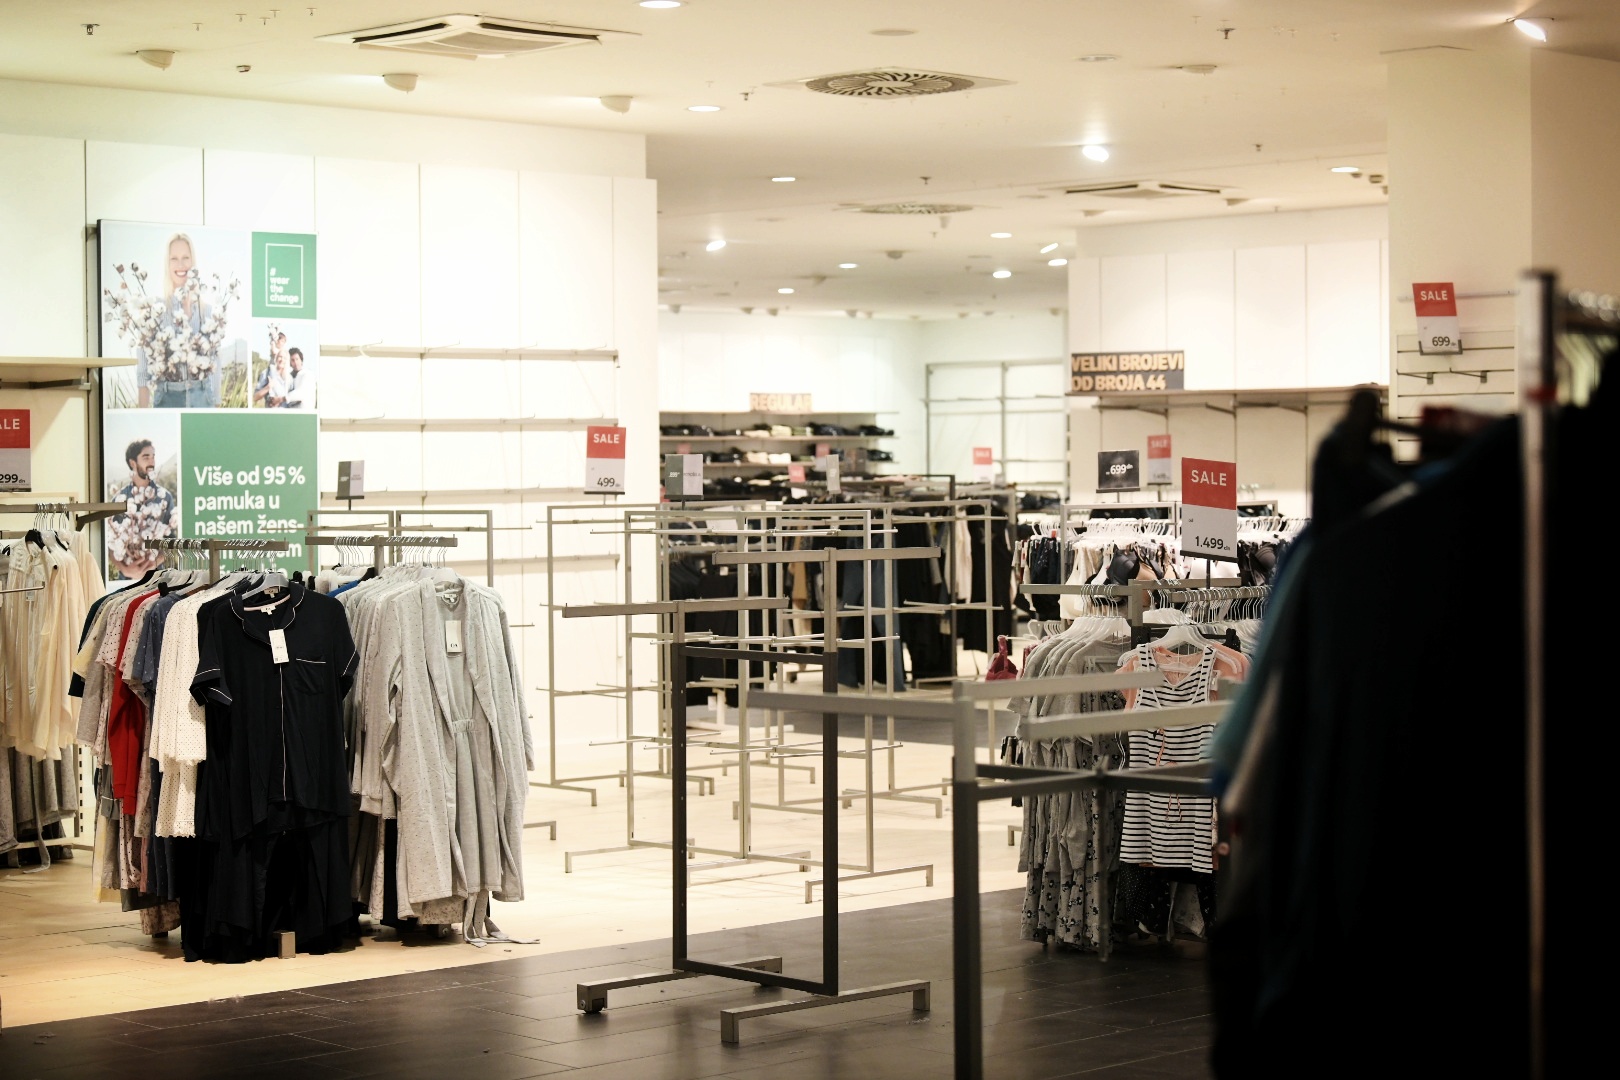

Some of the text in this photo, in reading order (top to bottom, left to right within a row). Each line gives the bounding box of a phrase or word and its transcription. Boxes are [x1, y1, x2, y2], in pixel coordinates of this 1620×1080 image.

[270, 284, 284, 293] the
[270, 294, 299, 304] change
[1420, 290, 1448, 301] SALE
[1432, 336, 1450, 347] 699
[1071, 353, 1184, 372] VELIKI BROJEVI
[1071, 373, 1166, 391] OD BROJA 44
[751, 394, 811, 413] REGULAR
[0, 418, 20, 430] LE
[593, 433, 620, 444] SALE
[194, 465, 233, 485] Više
[236, 465, 260, 485] od
[1110, 464, 1126, 475] 699
[597, 478, 615, 487] 499
[1191, 469, 1227, 486] SALE
[194, 490, 280, 515] pamuka u
[194, 514, 305, 535] našem žens-
[1195, 536, 1224, 549] 1.499
